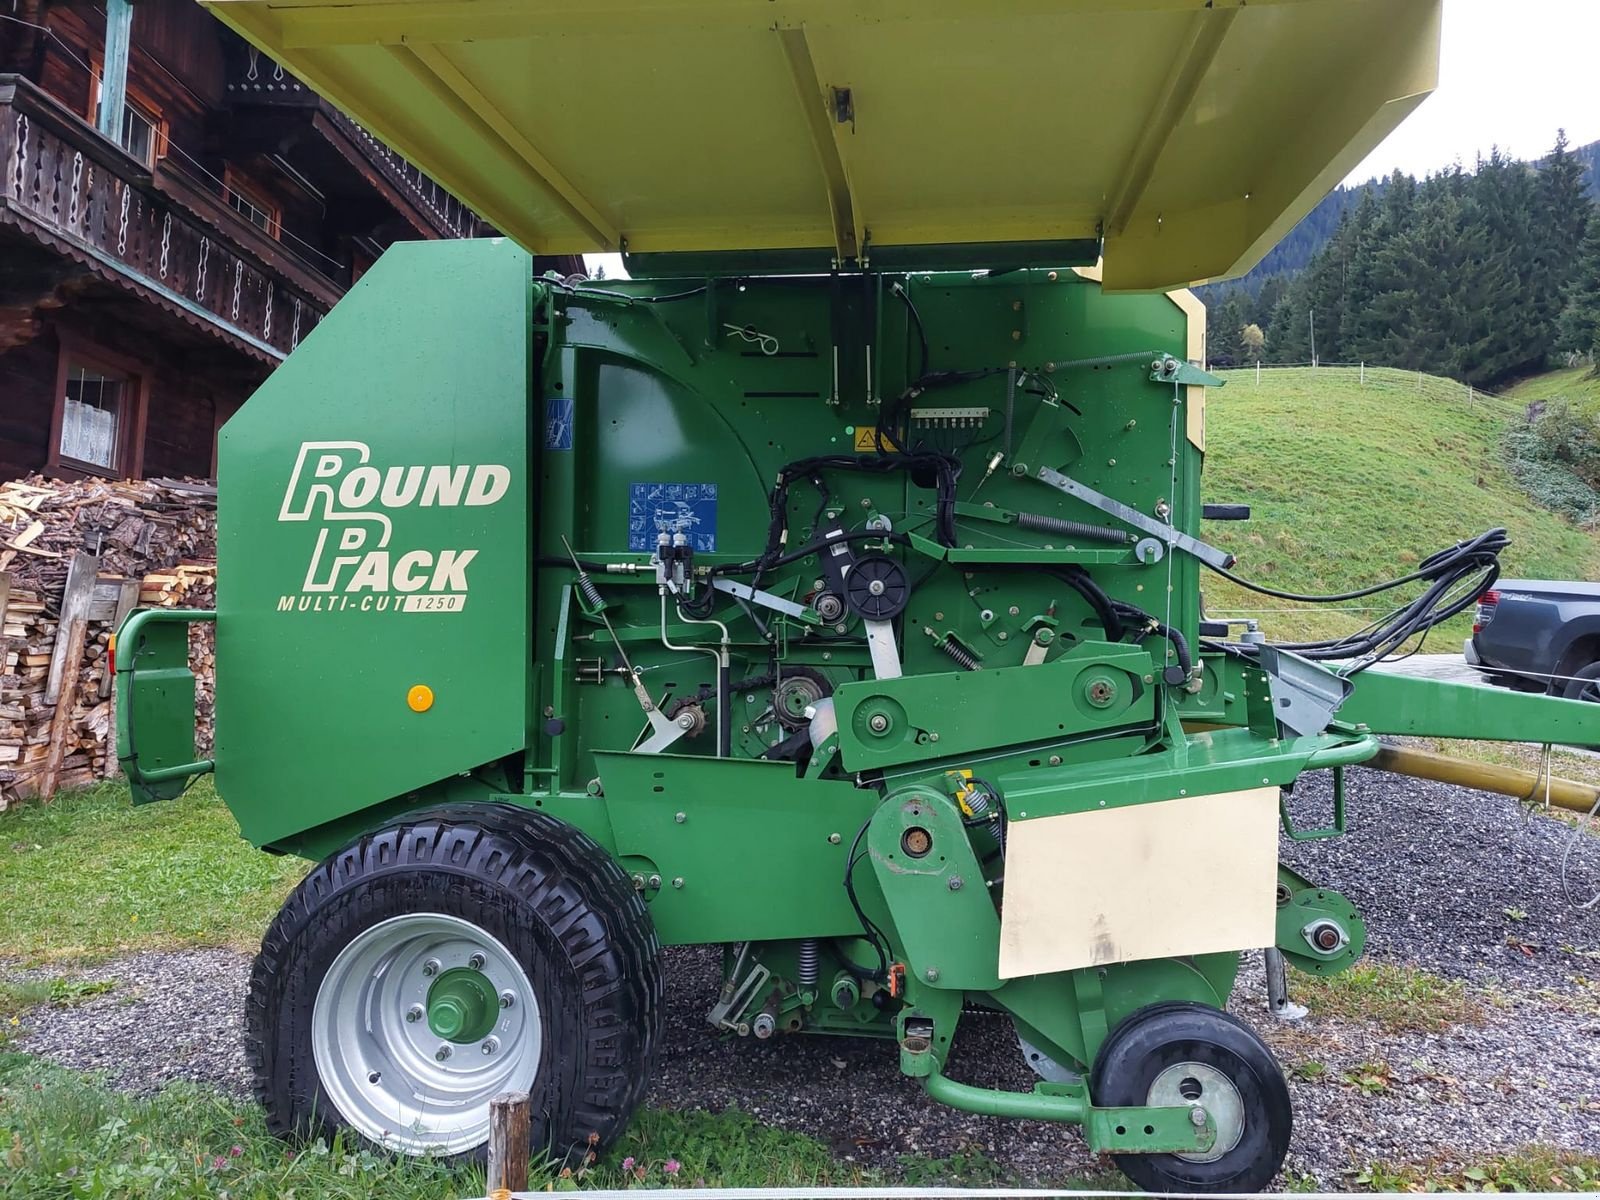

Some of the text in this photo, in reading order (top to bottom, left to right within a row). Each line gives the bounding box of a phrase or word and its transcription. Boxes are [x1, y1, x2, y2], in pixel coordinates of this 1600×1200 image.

[277, 441, 511, 521] ROUND
[302, 511, 479, 592] PACK
[276, 595, 457, 612] MULTI-CUT 1250
